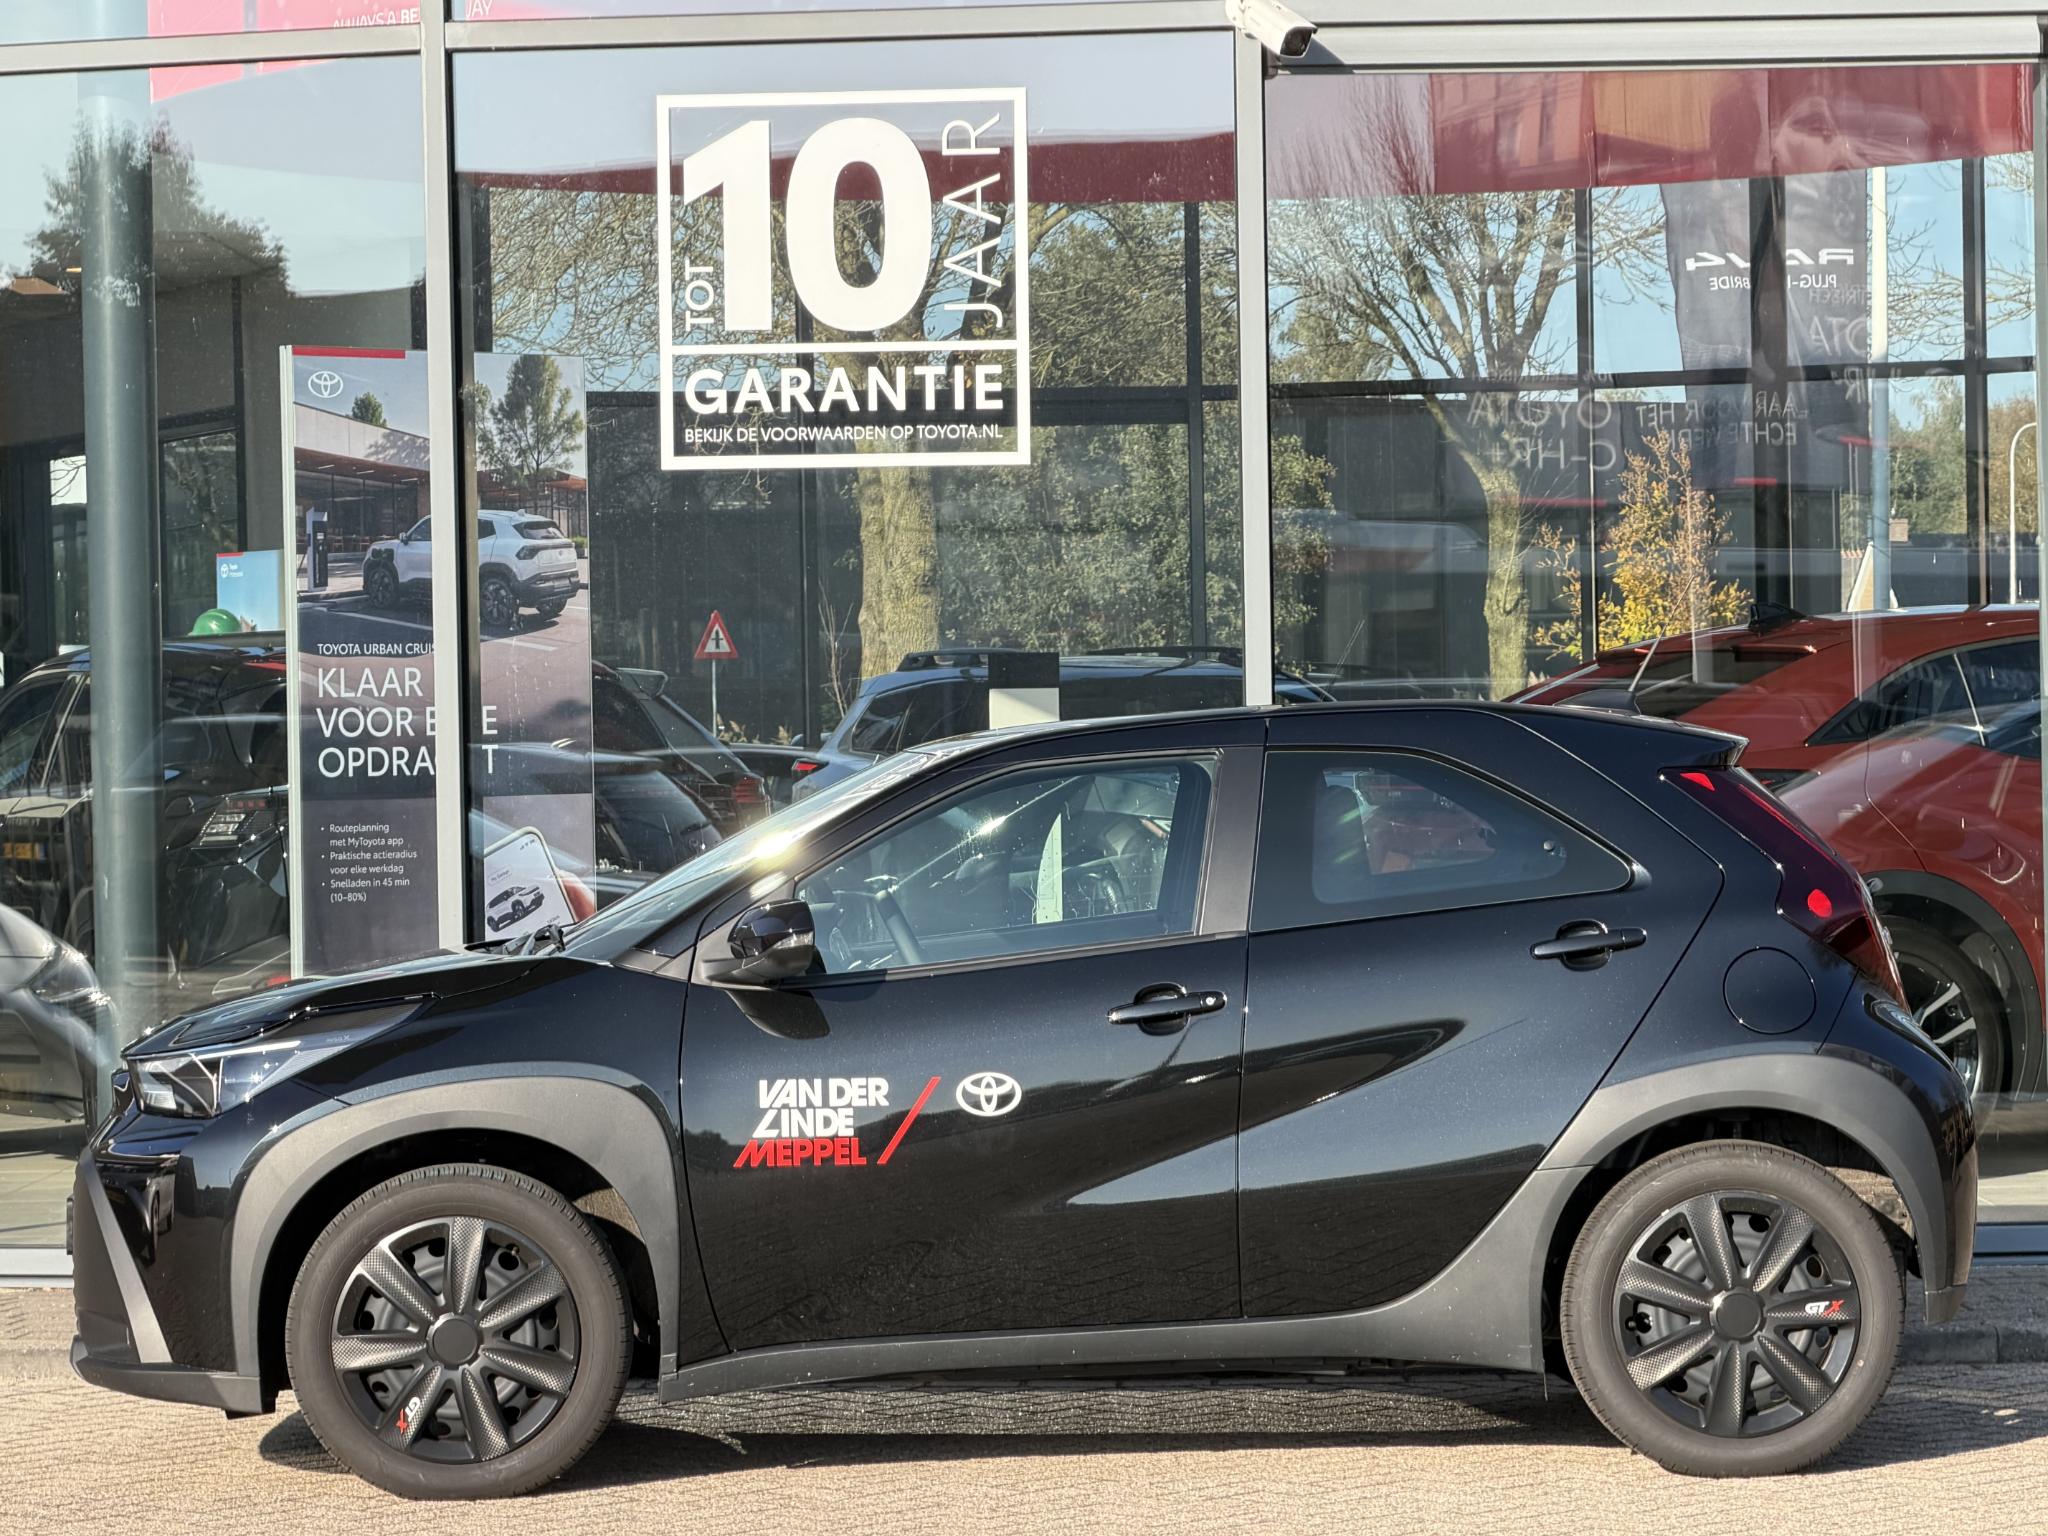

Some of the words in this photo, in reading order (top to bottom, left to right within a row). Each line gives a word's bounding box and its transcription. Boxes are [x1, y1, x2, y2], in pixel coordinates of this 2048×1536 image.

[683, 117, 932, 331] 10
[942, 113, 1002, 328] JAAR
[685, 260, 714, 331] TOT
[685, 364, 1004, 415] GARANTIE
[685, 427, 733, 443] BEKIJK
[736, 427, 757, 442] DE
[761, 425, 887, 442] VOORWAARDEN
[890, 425, 914, 440] OP
[916, 423, 1004, 440] TOYOTA.NL
[317, 643, 360, 656] TOYOTA
[363, 643, 402, 655] URBAN
[318, 667, 423, 698] KLAAR
[316, 706, 415, 738] VOOR
[318, 744, 499, 778] OPDRAT
[329, 822, 390, 834] Routeplanning
[329, 838, 346, 847] met
[347, 837, 386, 848] MyToyota
[387, 837, 404, 847] app
[330, 851, 371, 860] Praktische
[372, 850, 418, 860] actieradius
[330, 867, 348, 875] voor
[350, 864, 367, 874] elke
[369, 864, 404, 875] werkdag
[330, 879, 371, 889] Snelladen
[373, 878, 381, 887] in
[383, 877, 393, 887] 45
[394, 877, 410, 887] min
[759, 1077, 823, 1108] VAN
[829, 1077, 890, 1107] DER
[752, 1108, 855, 1138] LINDE
[732, 1137, 867, 1168] MEPPEL
[1804, 1300, 1845, 1316] GTX
[395, 1396, 421, 1435] GTX
